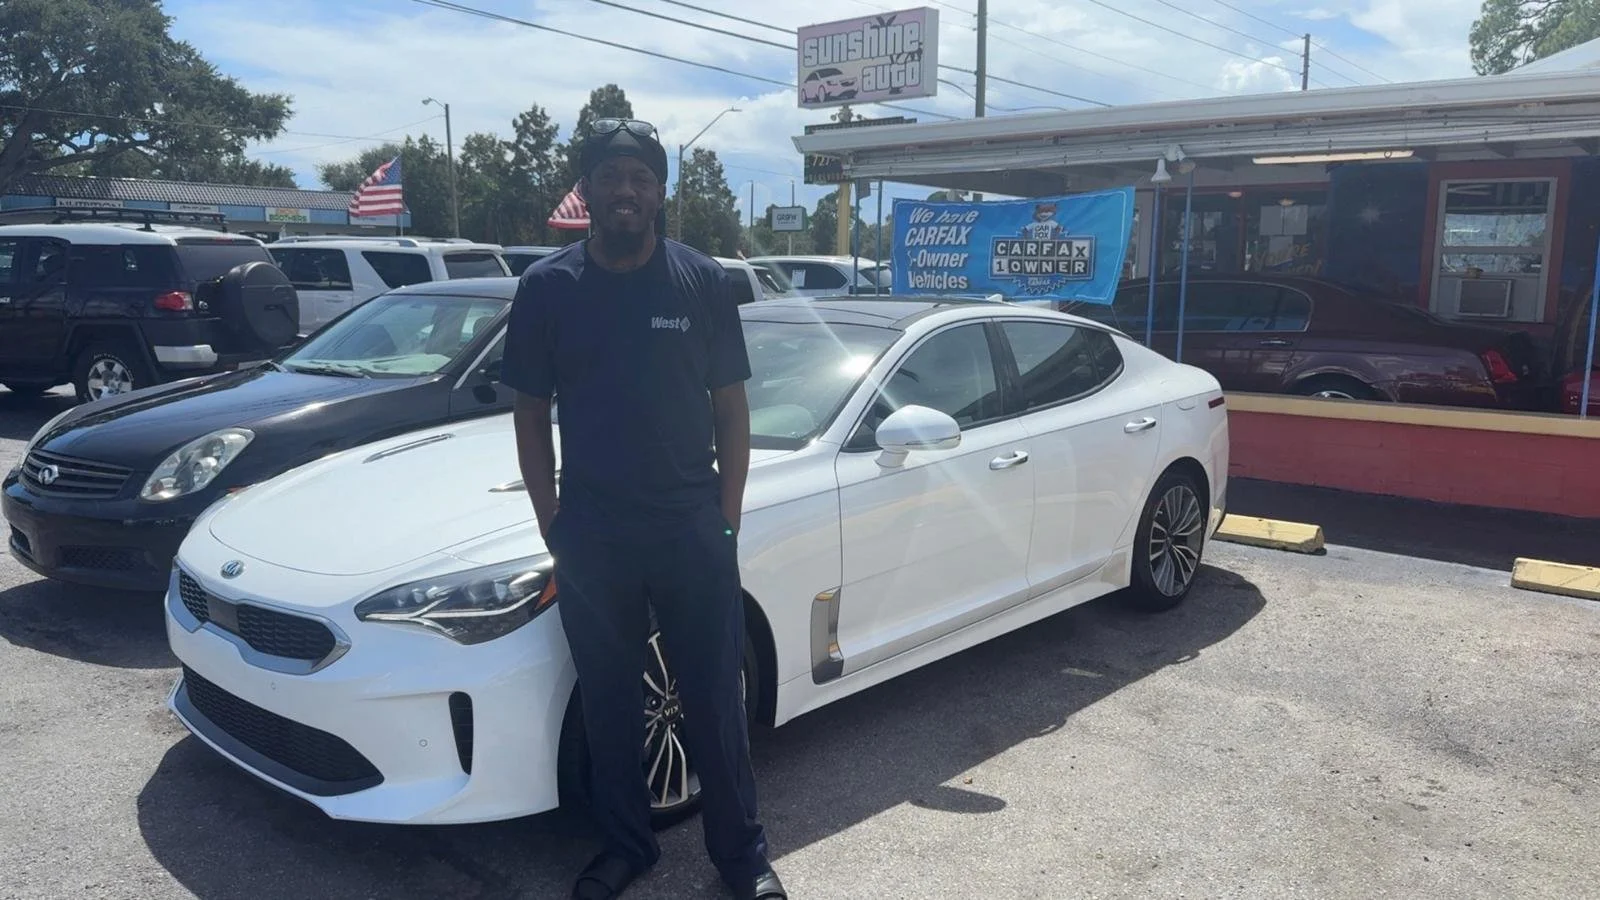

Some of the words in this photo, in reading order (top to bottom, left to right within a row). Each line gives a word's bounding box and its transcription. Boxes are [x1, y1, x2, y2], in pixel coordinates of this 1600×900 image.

[803, 21, 921, 68] sunshine
[861, 59, 921, 92] auto
[909, 207, 935, 224] We
[935, 209, 980, 224] have
[904, 226, 973, 247] CARFAX
[1034, 224, 1050, 232] CAR
[906, 248, 969, 268] -Owner
[996, 242, 1087, 258] CARFAX
[1010, 261, 1086, 273] OWNER
[908, 270, 969, 290] Vehicles
[651, 316, 680, 329] West
